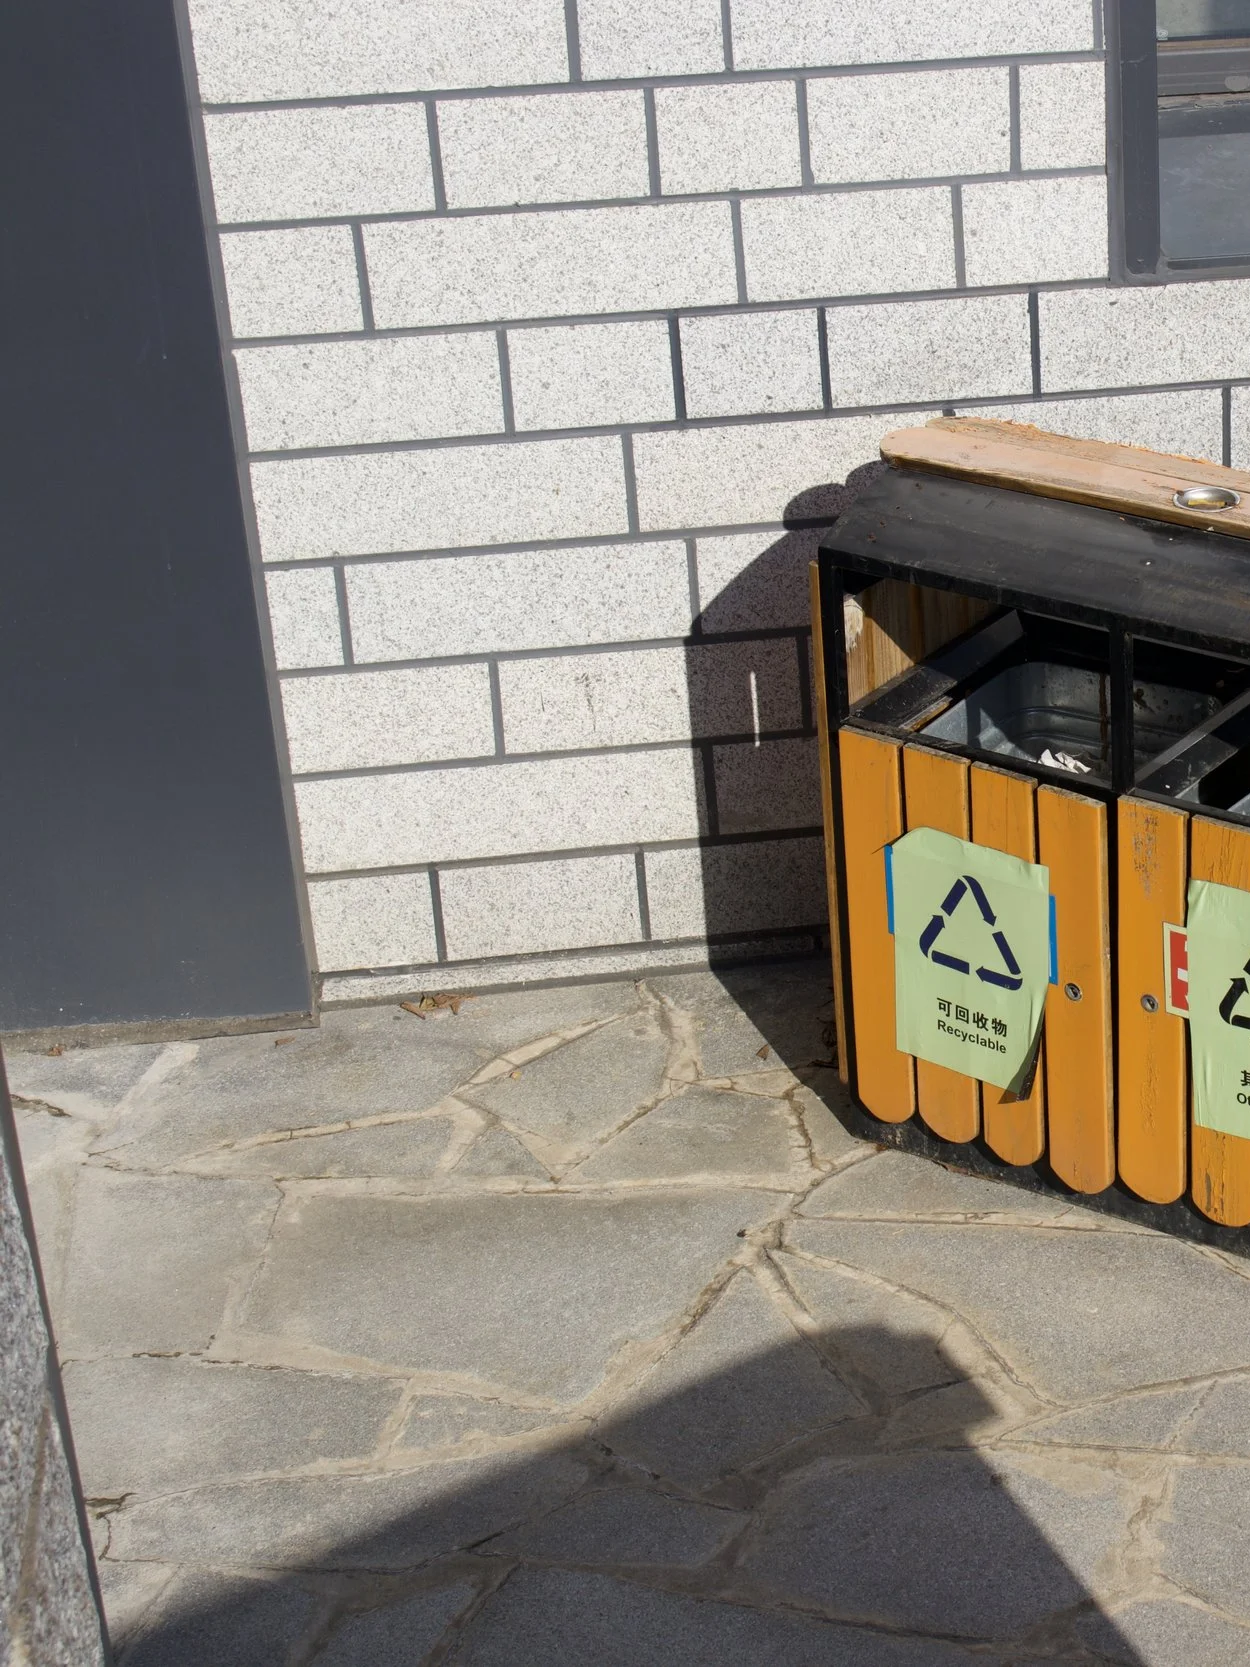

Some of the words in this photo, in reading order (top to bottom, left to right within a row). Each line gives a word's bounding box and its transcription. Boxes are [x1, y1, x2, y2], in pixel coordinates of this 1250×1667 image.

[936, 997, 1008, 1038] 可回收物
[937, 1019, 1007, 1054] Recyclable
